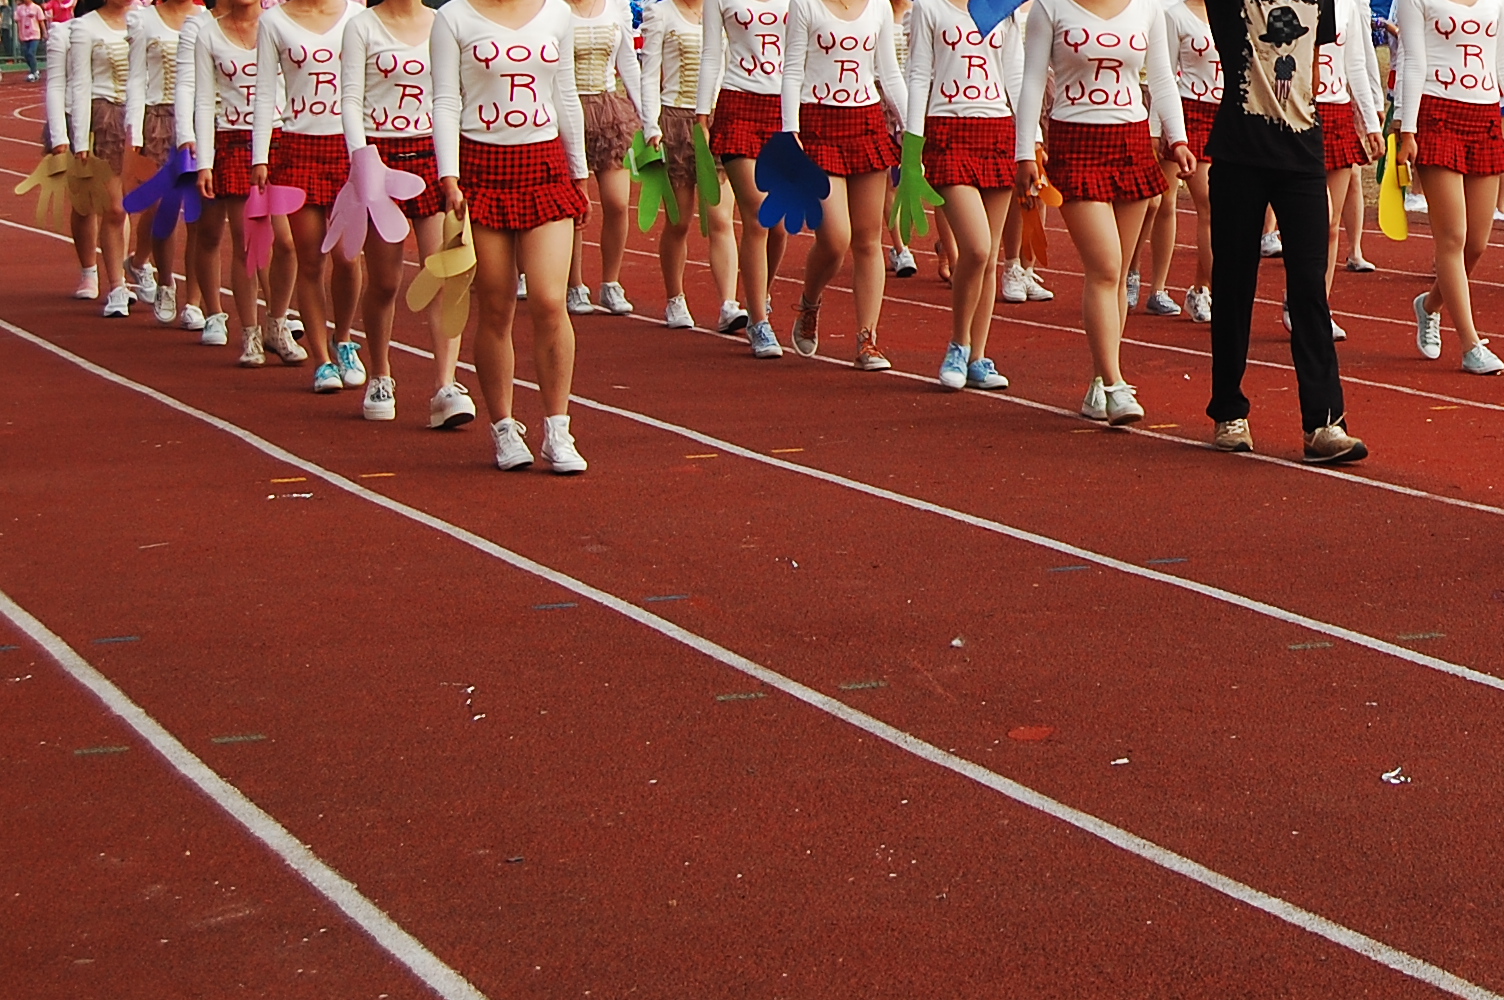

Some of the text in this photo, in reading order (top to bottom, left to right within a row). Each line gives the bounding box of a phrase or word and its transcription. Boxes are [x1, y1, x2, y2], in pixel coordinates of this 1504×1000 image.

[942, 25, 1004, 51] YOU
[1063, 28, 1148, 53] YOU
[1435, 16, 1499, 40] YOU
[473, 41, 560, 69] YOU
[754, 33, 781, 56] R
[817, 31, 877, 55] YOU
[288, 45, 342, 69] YO
[375, 53, 425, 78] YO
[961, 55, 989, 80] R
[1456, 44, 1485, 70] R
[834, 60, 860, 83] R
[1087, 57, 1123, 84] R
[1435, 67, 1495, 91] YOU
[308, 71, 337, 96] R
[500, 73, 537, 102] R
[812, 83, 871, 104] YOU
[940, 79, 1000, 103] YOU
[1064, 80, 1132, 106] YOU
[394, 83, 424, 110] R
[478, 102, 551, 131] YOU
